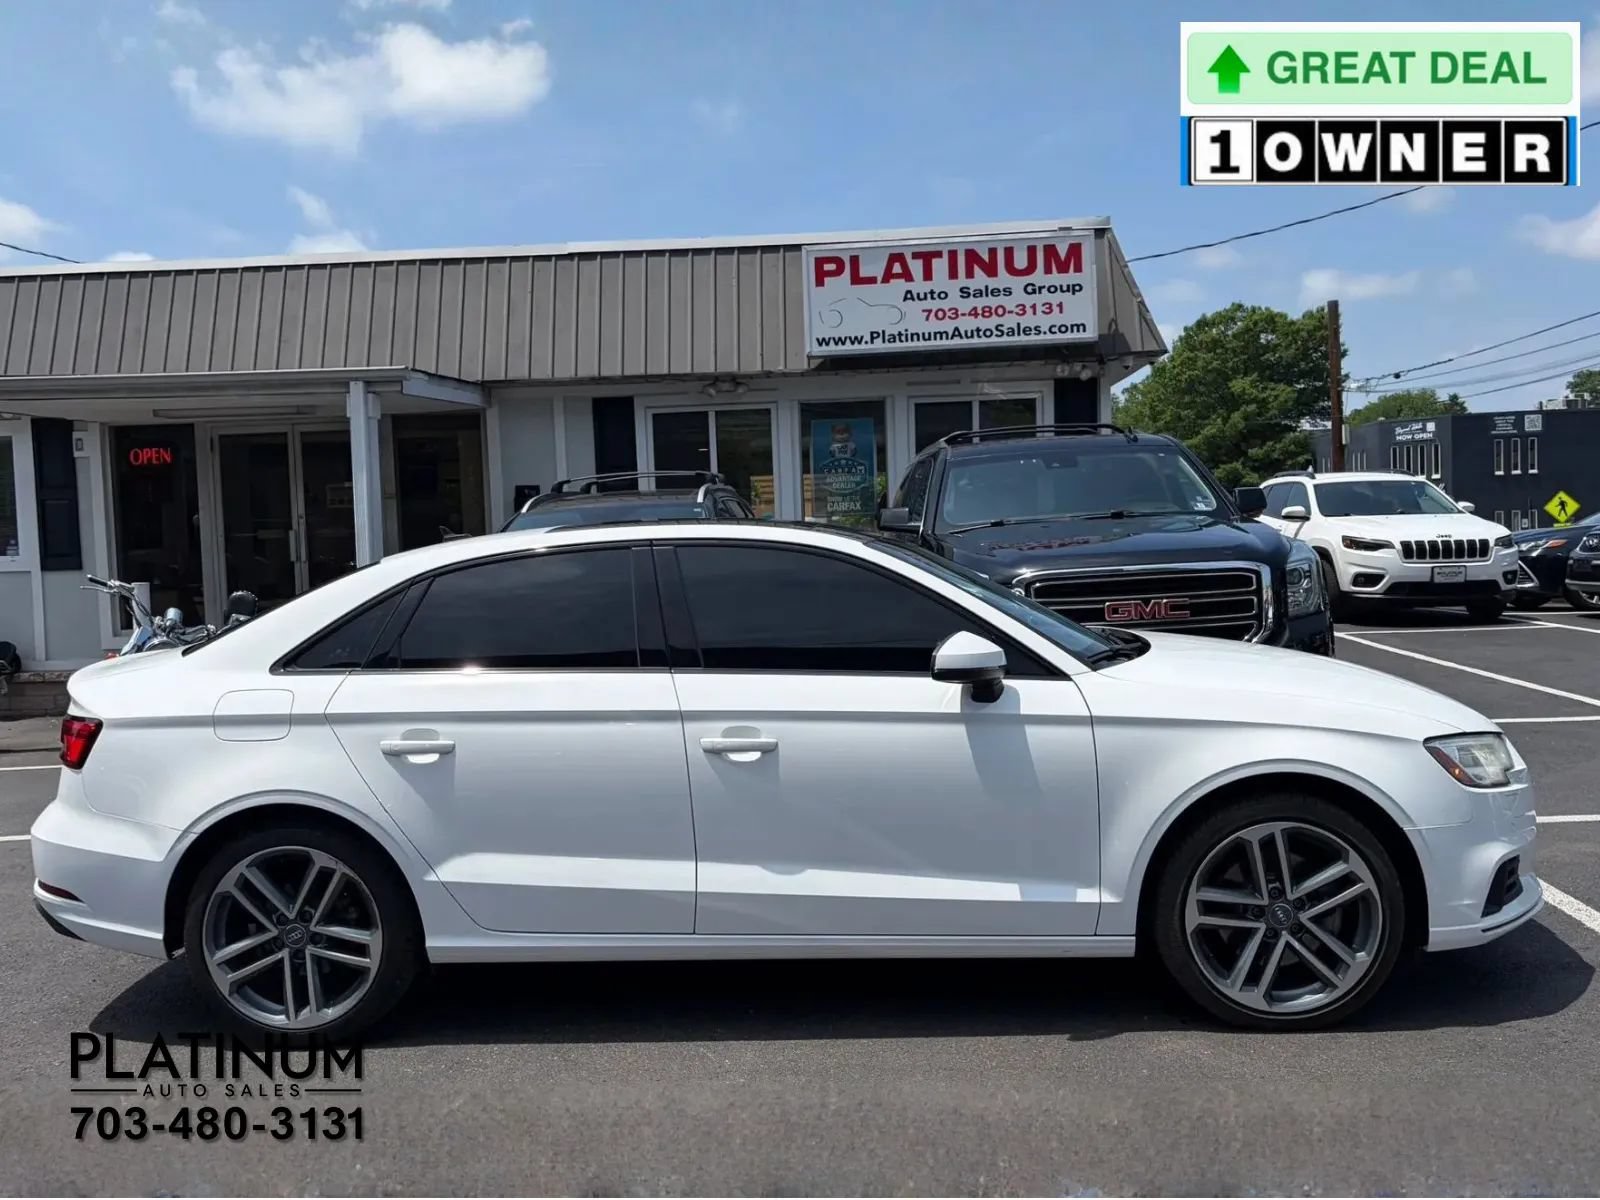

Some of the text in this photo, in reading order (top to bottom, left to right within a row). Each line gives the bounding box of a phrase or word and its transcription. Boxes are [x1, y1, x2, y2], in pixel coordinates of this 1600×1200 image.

[813, 242, 1084, 288] PLATINUM
[902, 281, 1084, 303] Auto Sales Group
[921, 301, 1065, 322] 703-480-3131
[815, 321, 1087, 348] www.PlatinumAutoSales.com
[129, 447, 173, 465] OPEN
[827, 502, 862, 512] CARFAX
[1104, 598, 1191, 621] GMC
